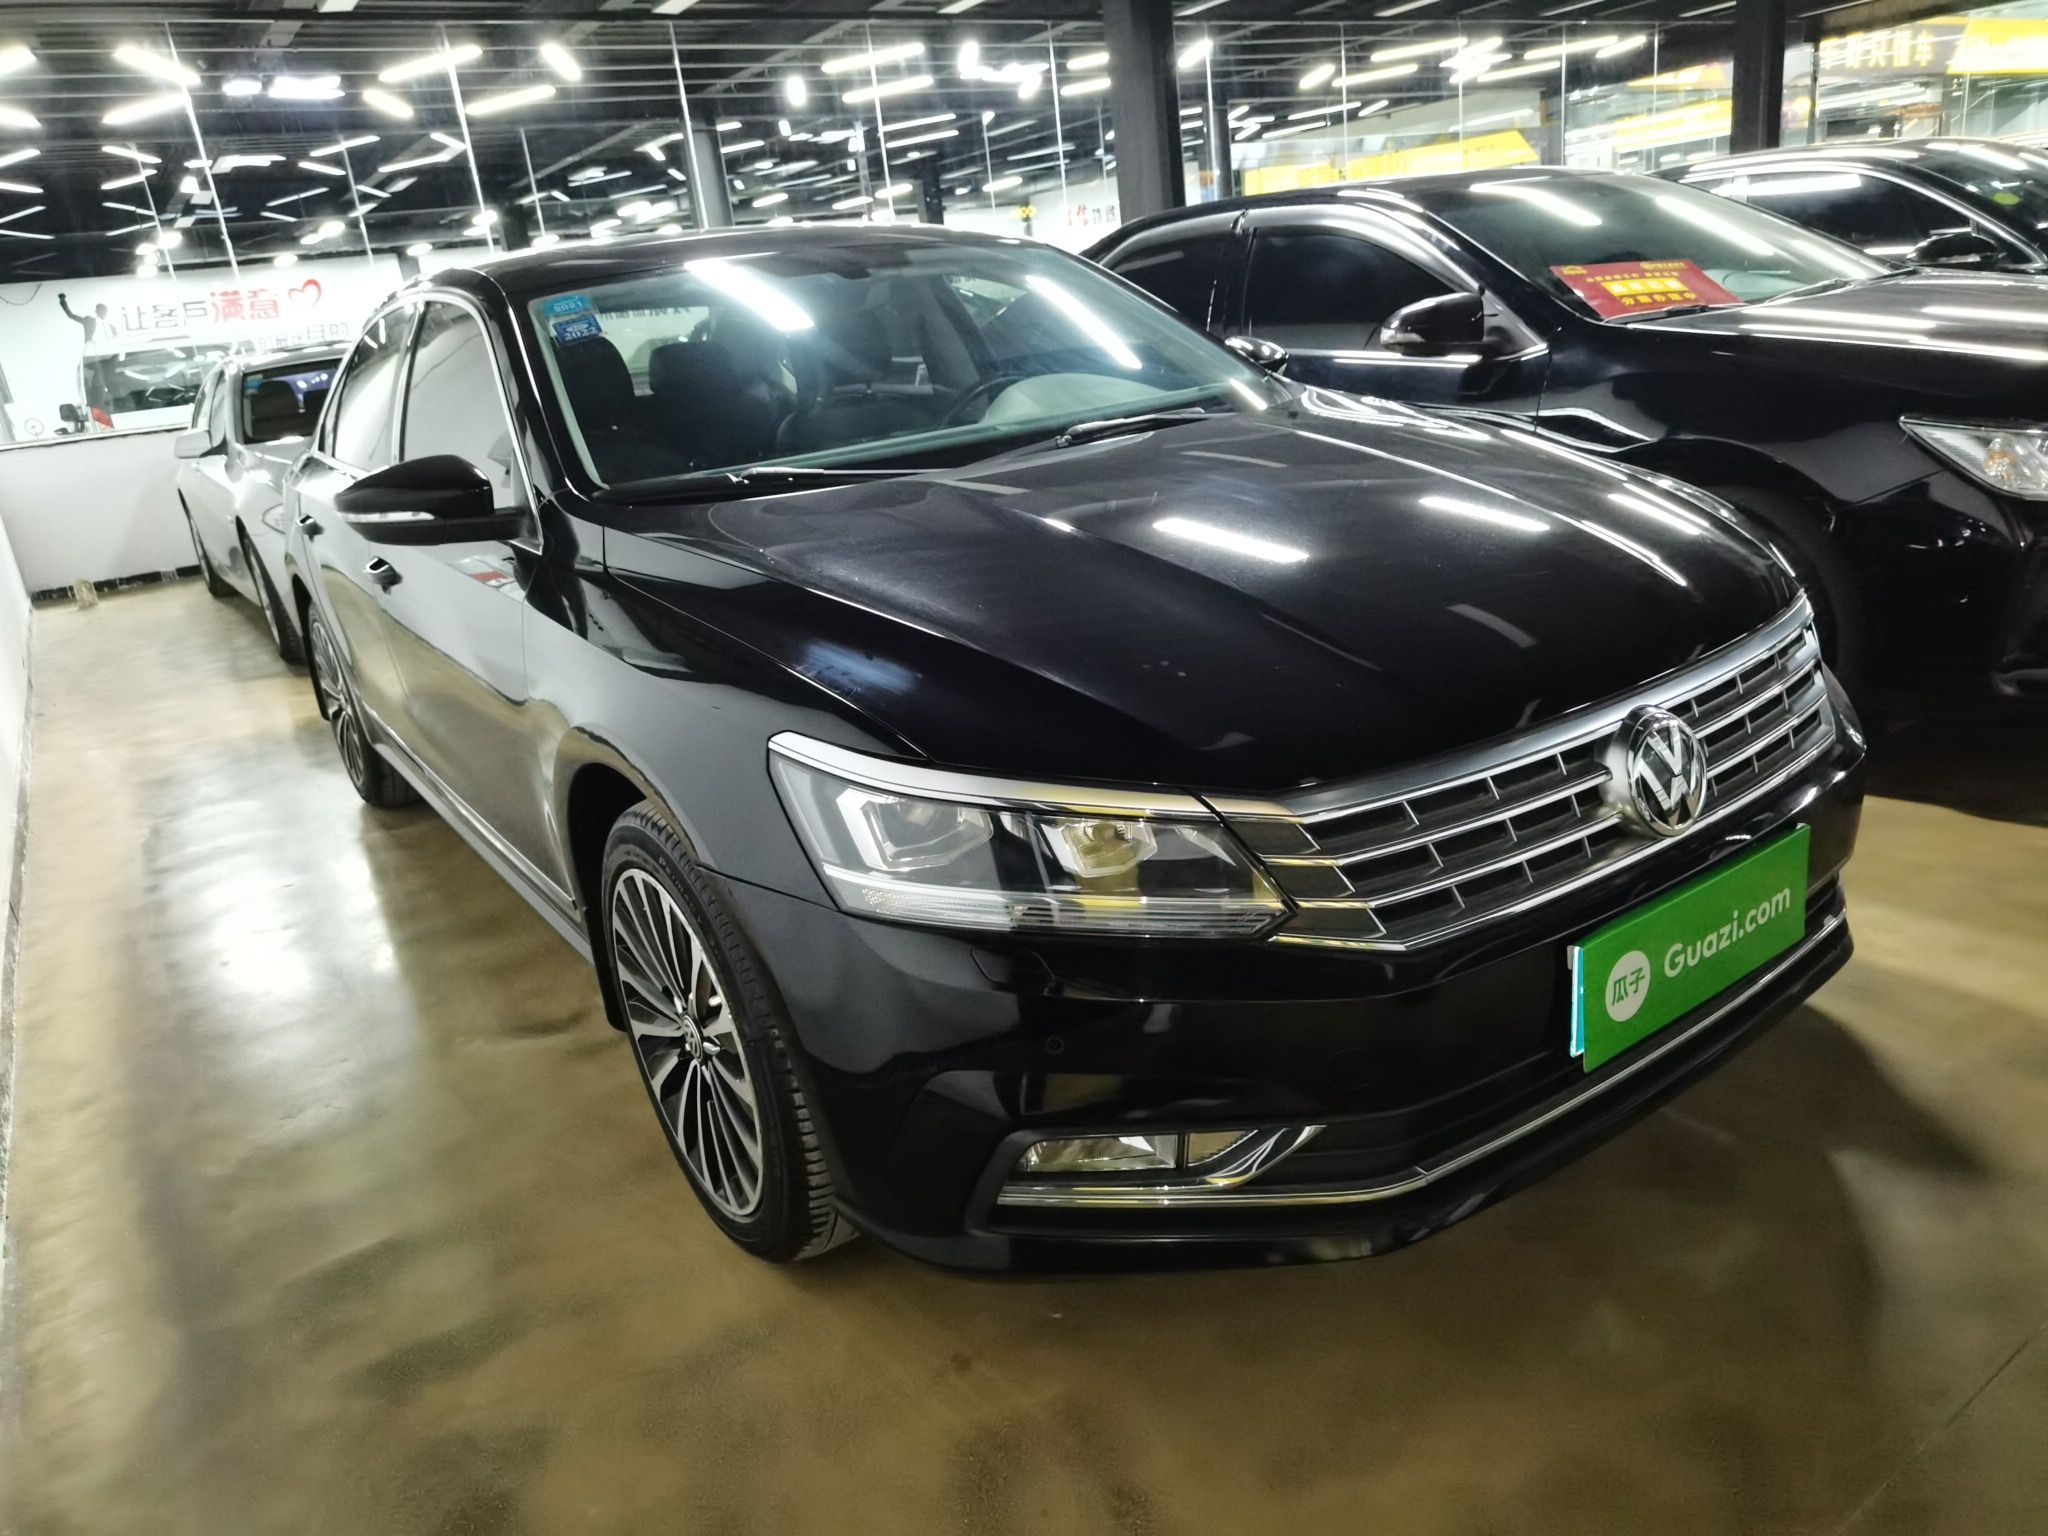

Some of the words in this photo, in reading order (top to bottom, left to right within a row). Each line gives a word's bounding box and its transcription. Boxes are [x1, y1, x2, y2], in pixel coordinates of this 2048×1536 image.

[121, 287, 280, 331] 让客户满意
[1664, 887, 1791, 978] Guazi.com
[1612, 967, 1646, 1007] 瓜子
